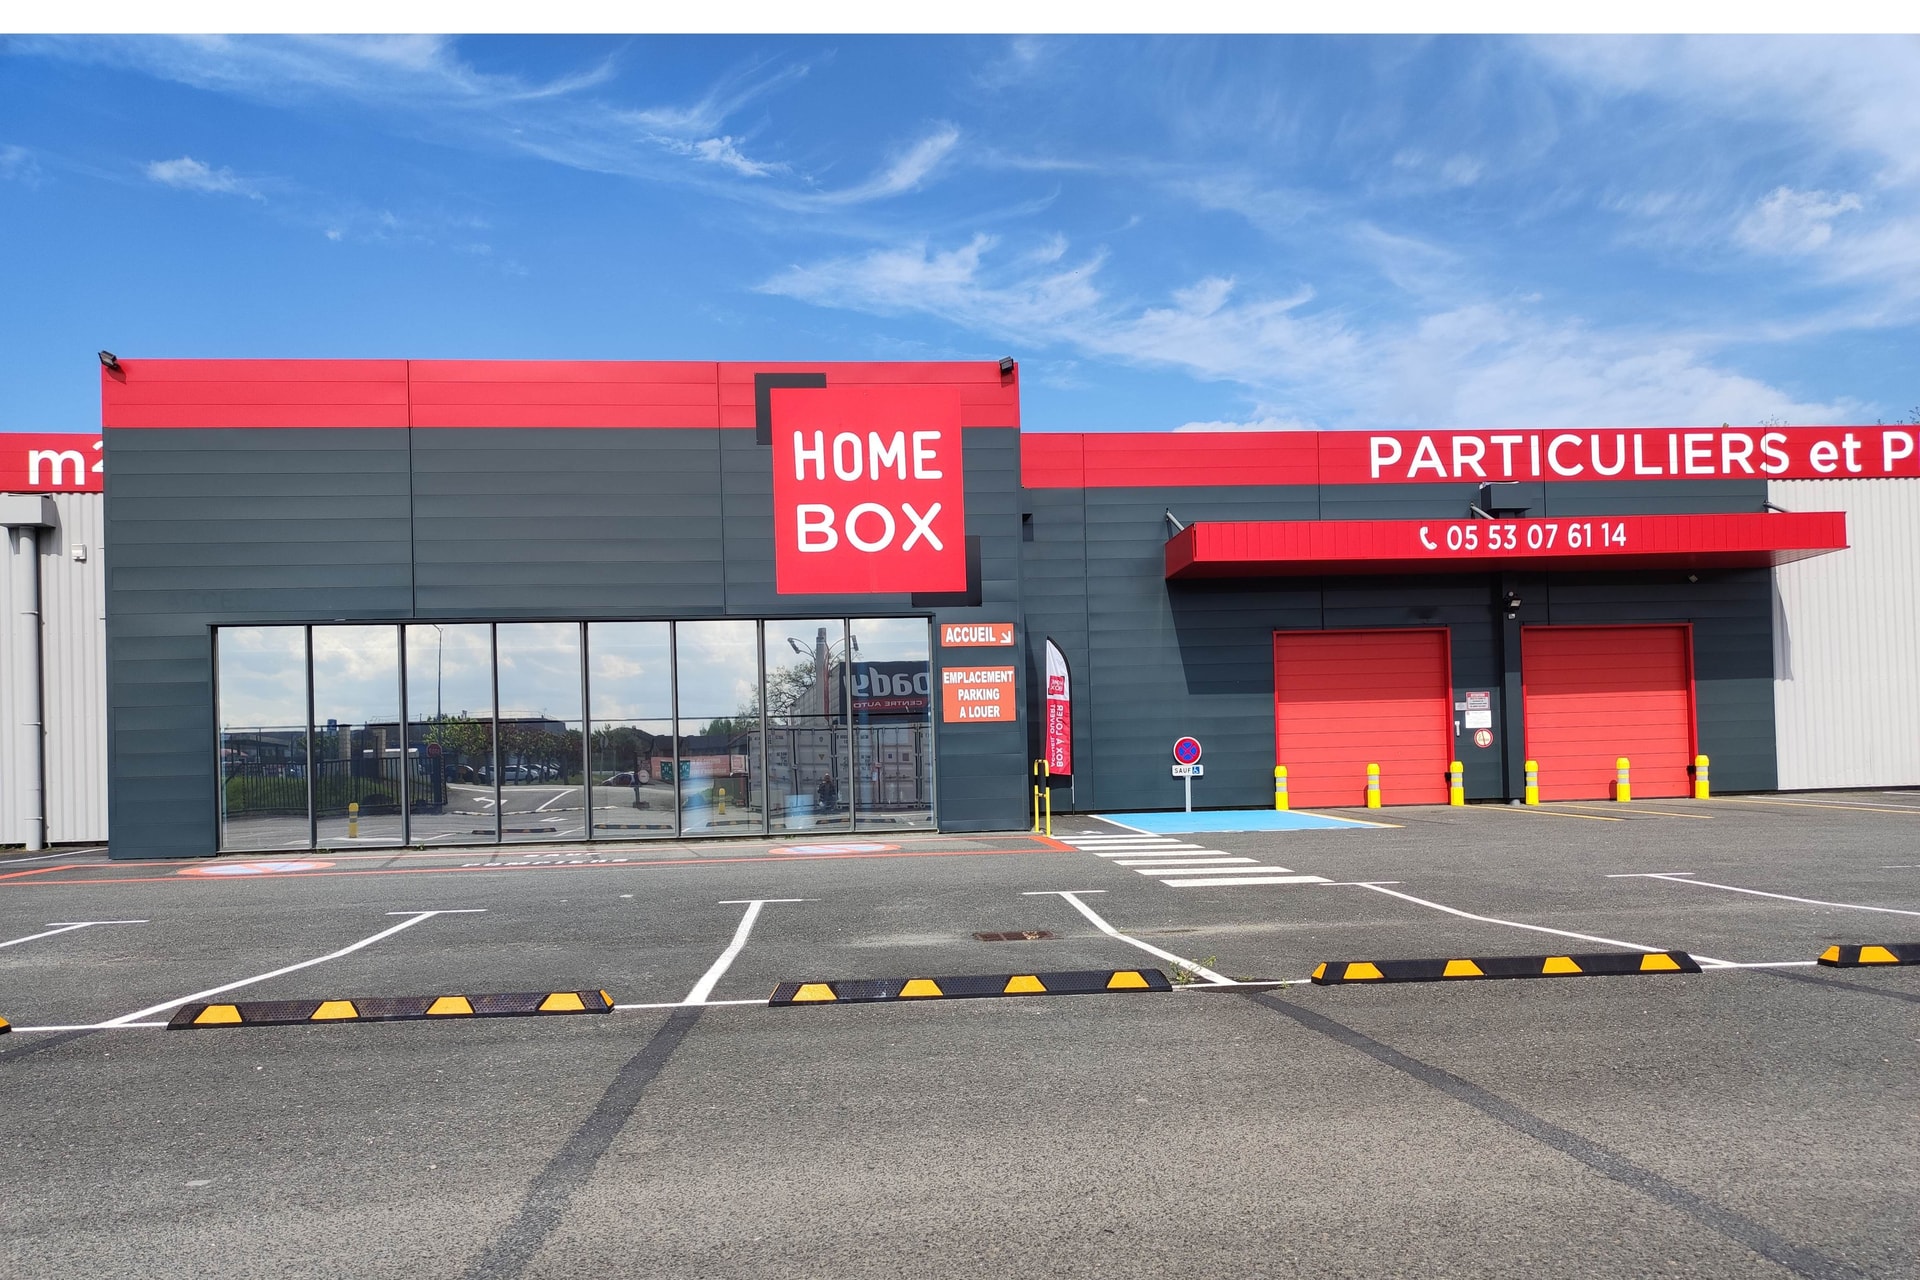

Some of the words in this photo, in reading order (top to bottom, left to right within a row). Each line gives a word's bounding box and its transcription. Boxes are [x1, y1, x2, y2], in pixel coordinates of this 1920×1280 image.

[793, 430, 943, 482] HOME
[1370, 432, 1790, 478] PARTICULIERS
[1809, 433, 1862, 473] et
[1882, 431, 1920, 472] P
[797, 502, 944, 553] BOX
[1447, 525, 1478, 550] 05
[1488, 524, 1517, 550] 53
[1527, 524, 1558, 549] 07
[1568, 523, 1591, 548] 61
[1601, 522, 1626, 547] 14
[945, 627, 996, 642] ACCUEIL
[943, 670, 1013, 684] EMPLACEMENT
[958, 688, 1000, 701] PARKING
[959, 706, 967, 718] A
[968, 705, 1000, 718] LOUER
